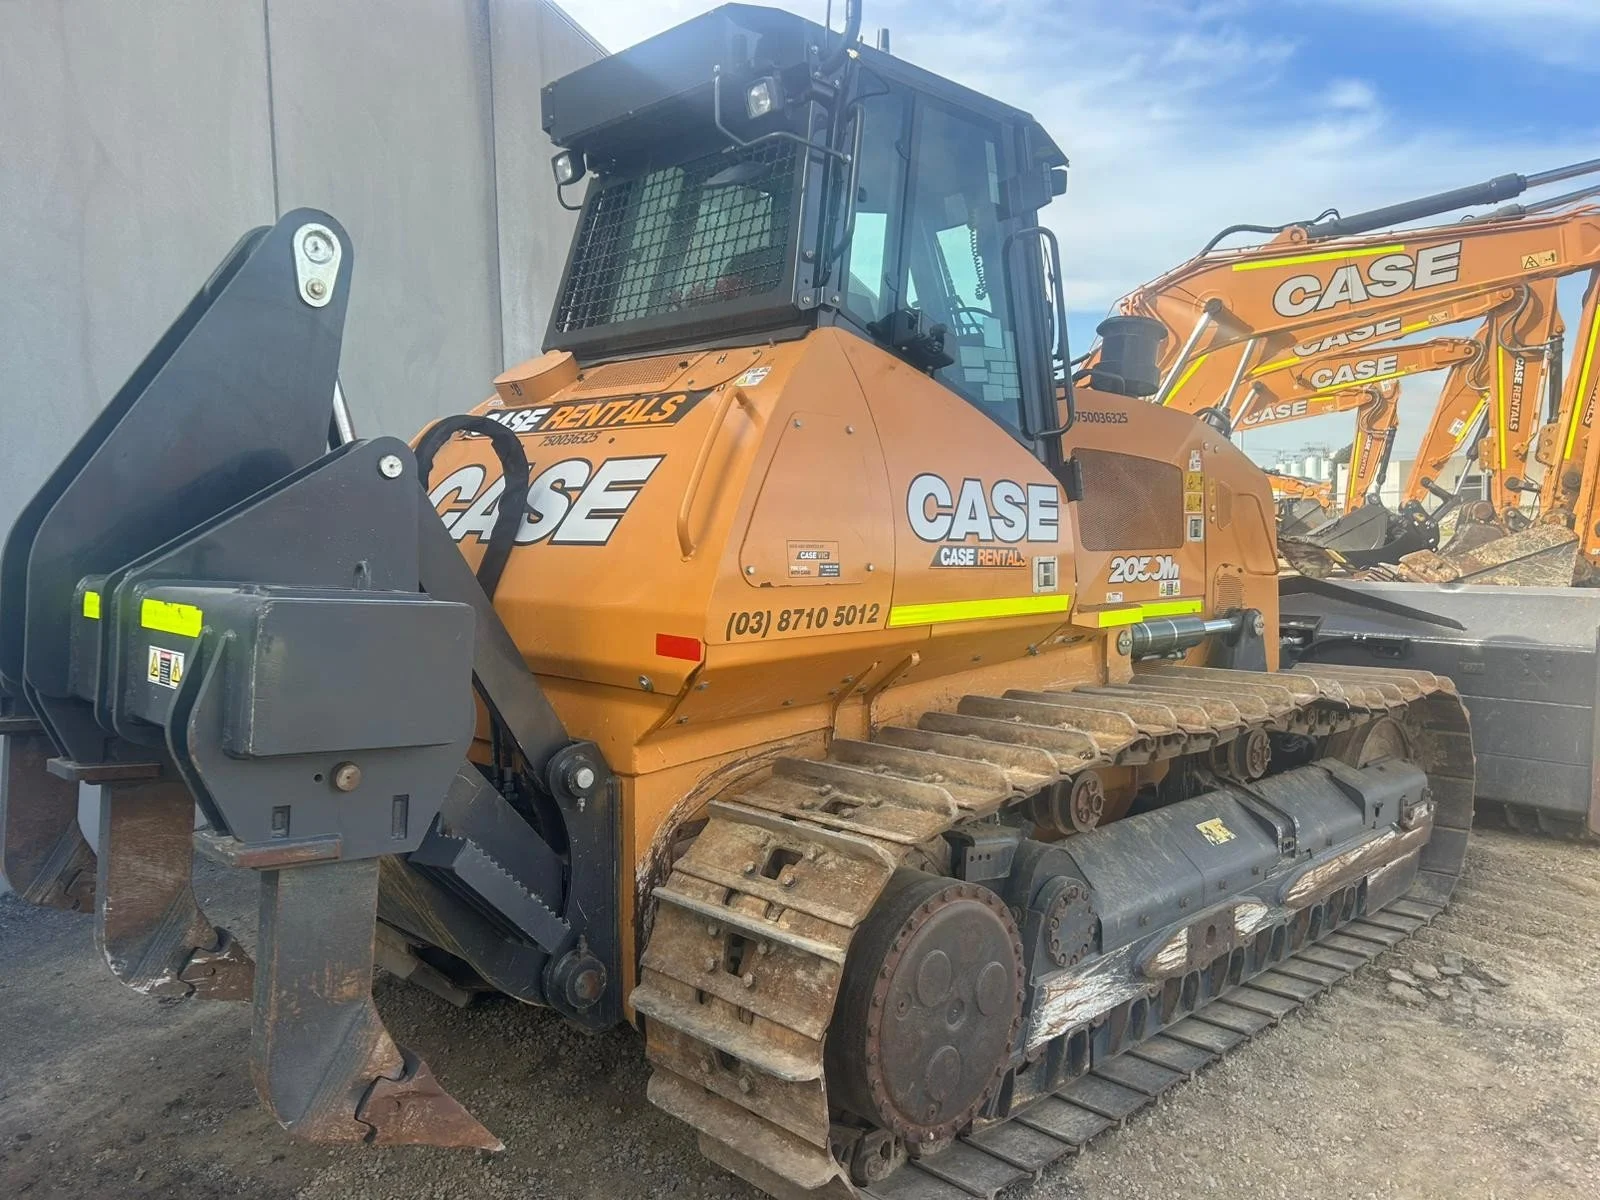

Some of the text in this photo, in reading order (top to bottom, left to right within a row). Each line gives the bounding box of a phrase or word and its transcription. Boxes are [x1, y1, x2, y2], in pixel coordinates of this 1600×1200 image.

[1273, 240, 1462, 318] CASE
[1311, 355, 1399, 389] CASE
[1509, 356, 1525, 431] CASE RENTALS
[538, 395, 687, 430] RENTALS
[907, 473, 1058, 543] CASE
[800, 551, 817, 559] CASE
[940, 547, 1026, 566] CASE RENTALS
[725, 602, 880, 642] (03) 8710 5012
